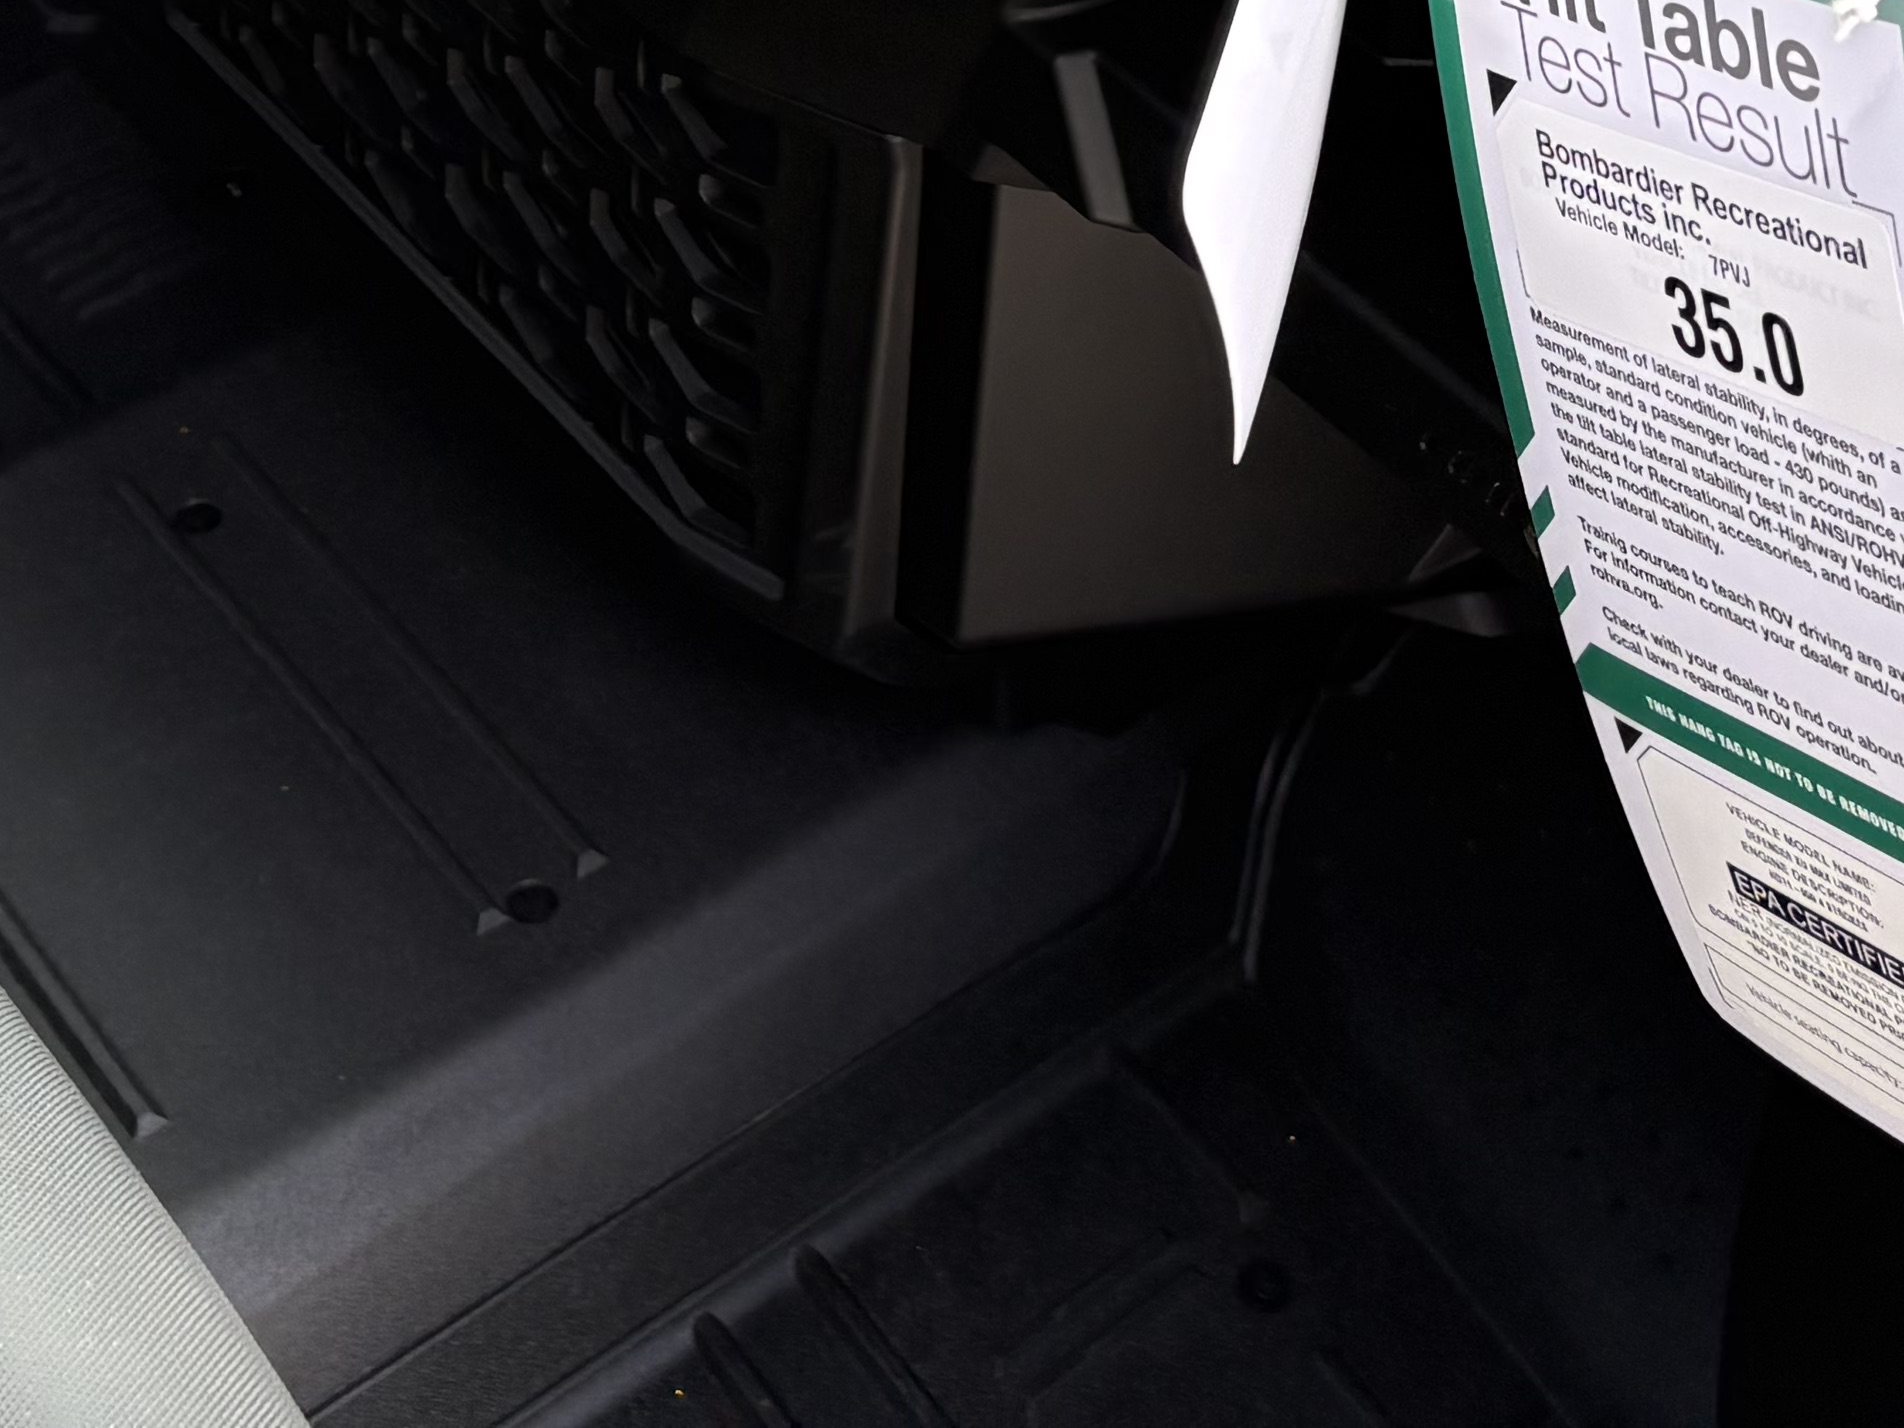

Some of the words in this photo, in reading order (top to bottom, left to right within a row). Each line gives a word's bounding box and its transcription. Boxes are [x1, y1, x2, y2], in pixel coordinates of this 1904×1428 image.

[1501, 0, 1630, 118] Test
[1644, 52, 1857, 198] Result
[1536, 129, 1683, 204] Bombardier
[1691, 183, 1867, 269] Recreational
[1542, 161, 1656, 224] Products
[1662, 203, 1711, 245] inc.
[1555, 197, 1618, 235] Vehicle
[1623, 221, 1684, 259] Model:
[1708, 254, 1750, 287] 7PVJ
[1530, 306, 1630, 362] Measurement
[1633, 354, 1647, 369] of
[1651, 357, 1700, 391] lateral
[1704, 383, 1769, 423] stability,
[1772, 407, 1788, 428] in
[1793, 418, 1864, 462] degrees,
[1869, 452, 1885, 468] of
[1891, 460, 1901, 474] a
[1665, 277, 1804, 396] 35.0
[1536, 334, 1591, 370] sample,
[1595, 360, 1661, 397] standard
[1665, 389, 1737, 429] condition
[1741, 421, 1797, 454] vehicle
[1857, 470, 1877, 488] an
[1541, 358, 1601, 393] operator
[1606, 387, 1633, 407] and
[1638, 400, 1647, 413] a
[1651, 406, 1730, 448] passenger
[1734, 436, 1769, 465] load
[1785, 460, 1813, 484] 430
[1818, 477, 1885, 518] pounds)
[1546, 382, 1617, 422] measured
[1619, 410, 1637, 434] by
[1642, 421, 1666, 443] the
[1671, 436, 1774, 489] manufacturer
[1778, 478, 1794, 498] in
[1799, 491, 1895, 542] accordance
[1551, 402, 1573, 424] the
[1576, 414, 1596, 434] tilt
[1599, 424, 1636, 451] table
[1639, 440, 1688, 474] lateral
[1692, 466, 1751, 504] stability
[1756, 492, 1787, 518] test
[1790, 505, 1805, 526] in
[1557, 428, 1620, 466] standard
[1623, 455, 1643, 476] for
[1648, 465, 1745, 521] Recreational
[1749, 510, 1847, 569] Off-Highway
[1561, 447, 1612, 483] Vehicle
[1617, 476, 1714, 531] modification,
[1718, 521, 1817, 578] accessories,
[1821, 568, 1851, 591] and
[1568, 474, 1609, 502] affect
[1611, 491, 1658, 525] lateral
[1662, 517, 1724, 555] stability.
[1584, 538, 1607, 562] For
[1700, 597, 1757, 633] contact
[1761, 626, 1795, 650] your
[1800, 644, 1848, 676] dealer
[1630, 545, 1689, 580] courses
[1692, 570, 1708, 589] to
[1712, 580, 1755, 611] teach
[1759, 601, 1792, 629] ROV
[1799, 621, 1852, 661] driving
[1857, 651, 1882, 672] are
[1602, 606, 1648, 640] Check
[1650, 633, 1683, 657] with
[1685, 650, 1717, 674] your
[1723, 668, 1768, 699] dealer
[1773, 692, 1789, 710] to
[1793, 701, 1824, 727] find
[1828, 721, 1854, 742] out
[1858, 736, 1904, 768] about
[1607, 627, 1643, 656] local
[1645, 646, 1679, 675] laws
[1683, 668, 1754, 715] regarding
[1757, 702, 1790, 730] ROV
[1796, 726, 1876, 774] operation.
[1646, 696, 1676, 721] THIS
[1679, 713, 1715, 742] HANG
[1717, 733, 1744, 756] TAG
[1746, 748, 1761, 766] IS
[1764, 758, 1791, 780] NOT
[1795, 772, 1813, 792] TO
[1817, 784, 1836, 805] BE
[1726, 802, 1780, 840] VEHICLE
[1784, 833, 1830, 868] MODEL
[1734, 871, 1785, 916] EPA
[1741, 840, 1789, 875] ENGINE
[1708, 904, 1790, 961] BOMBARDIER
[1792, 955, 1892, 1021] RECREATIONAL
[1746, 983, 1792, 1020] Vehicle
[1794, 1016, 1842, 1054] seating
[1773, 955, 1789, 972] TO
[1792, 967, 1810, 986] BE
[1812, 979, 1876, 1024] REMOVED
